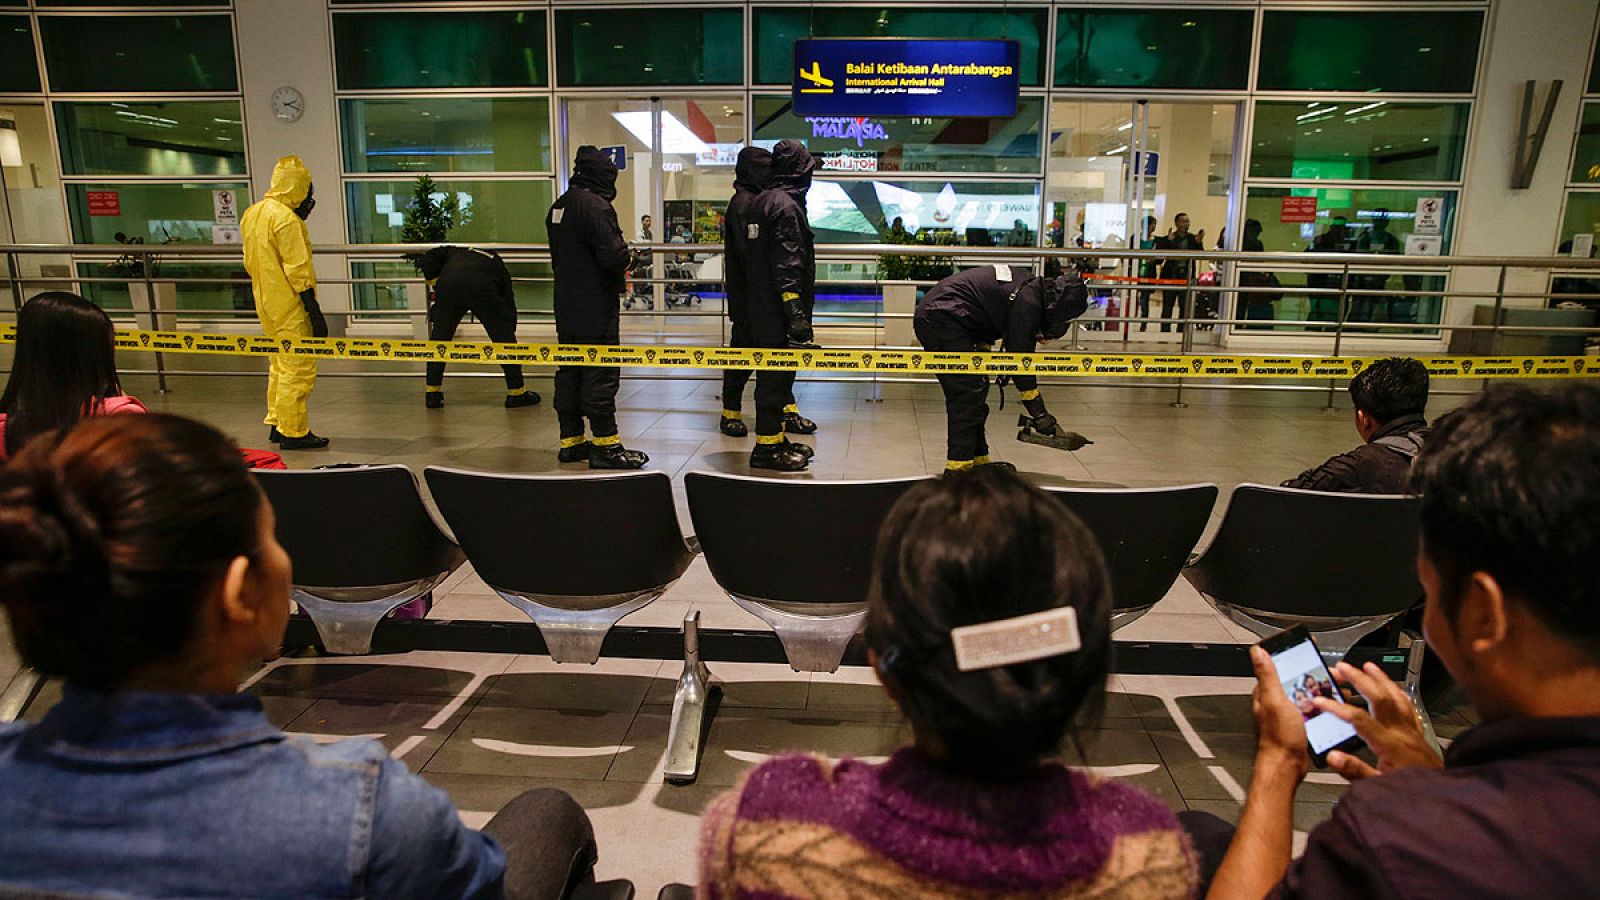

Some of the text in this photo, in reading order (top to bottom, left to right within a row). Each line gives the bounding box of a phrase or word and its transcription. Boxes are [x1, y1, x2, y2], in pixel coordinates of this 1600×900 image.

[845, 62, 1013, 78] Balai Ketibaan Antarabangsa
[845, 78, 945, 87] International Arrival Hall
